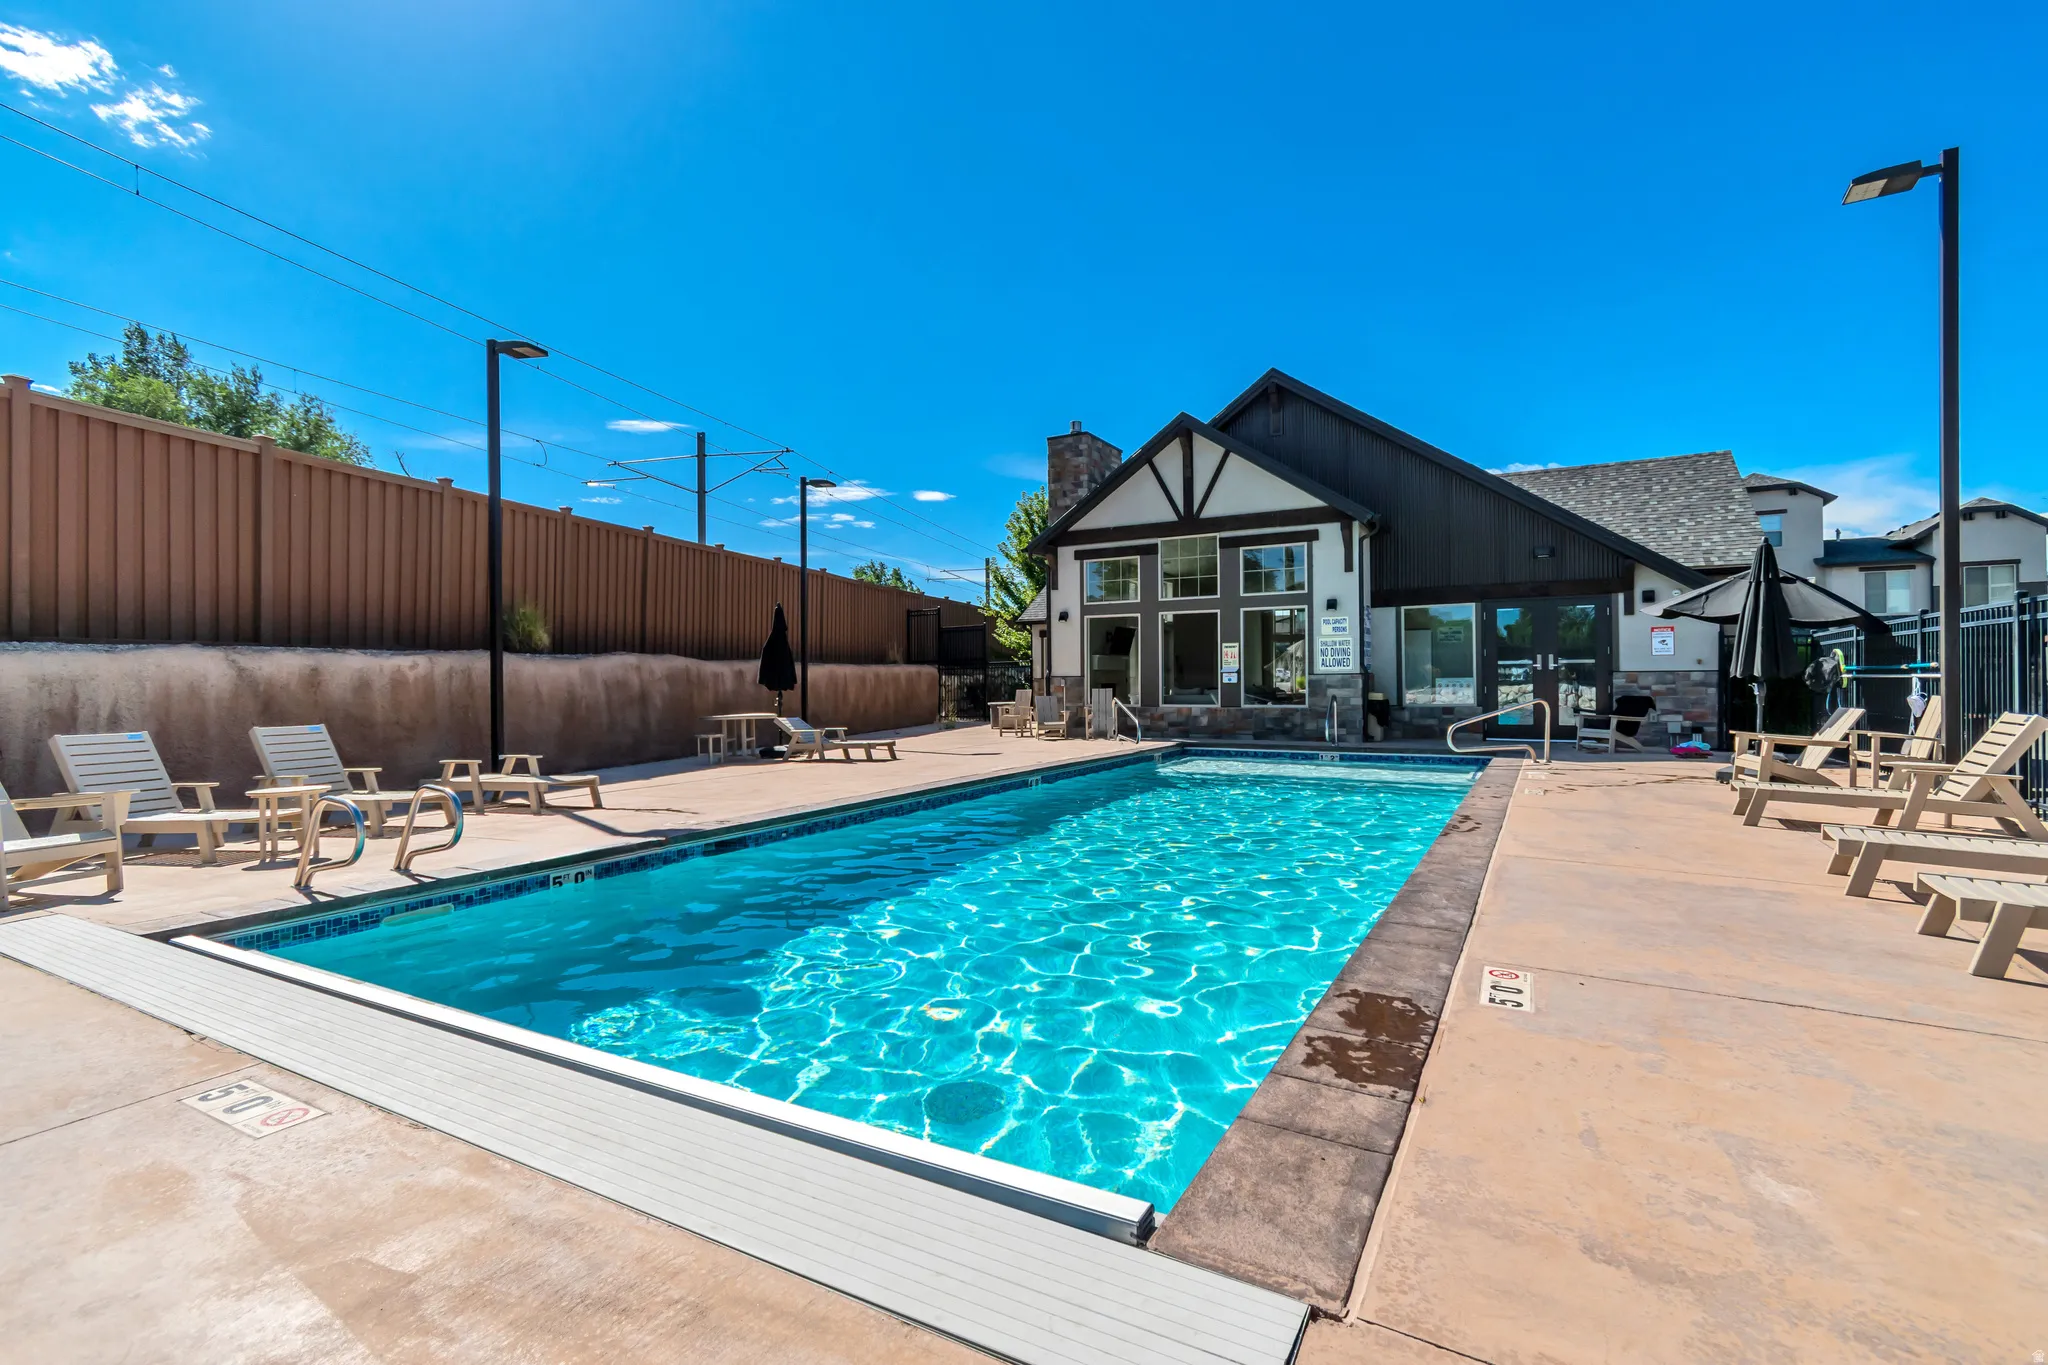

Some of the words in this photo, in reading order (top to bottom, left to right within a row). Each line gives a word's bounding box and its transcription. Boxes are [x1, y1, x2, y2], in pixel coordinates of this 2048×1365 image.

[1338, 639, 1350, 647] WATER
[1320, 647, 1329, 658] NO
[1330, 647, 1351, 658] DIVING
[1321, 657, 1351, 668] ALLOWED
[552, 875, 563, 888] 5
[574, 871, 585, 884] 0
[1490, 985, 1524, 994] 0
[1488, 997, 1524, 1007] 5
[198, 1084, 249, 1102] 5
[222, 1095, 274, 1115] 0
